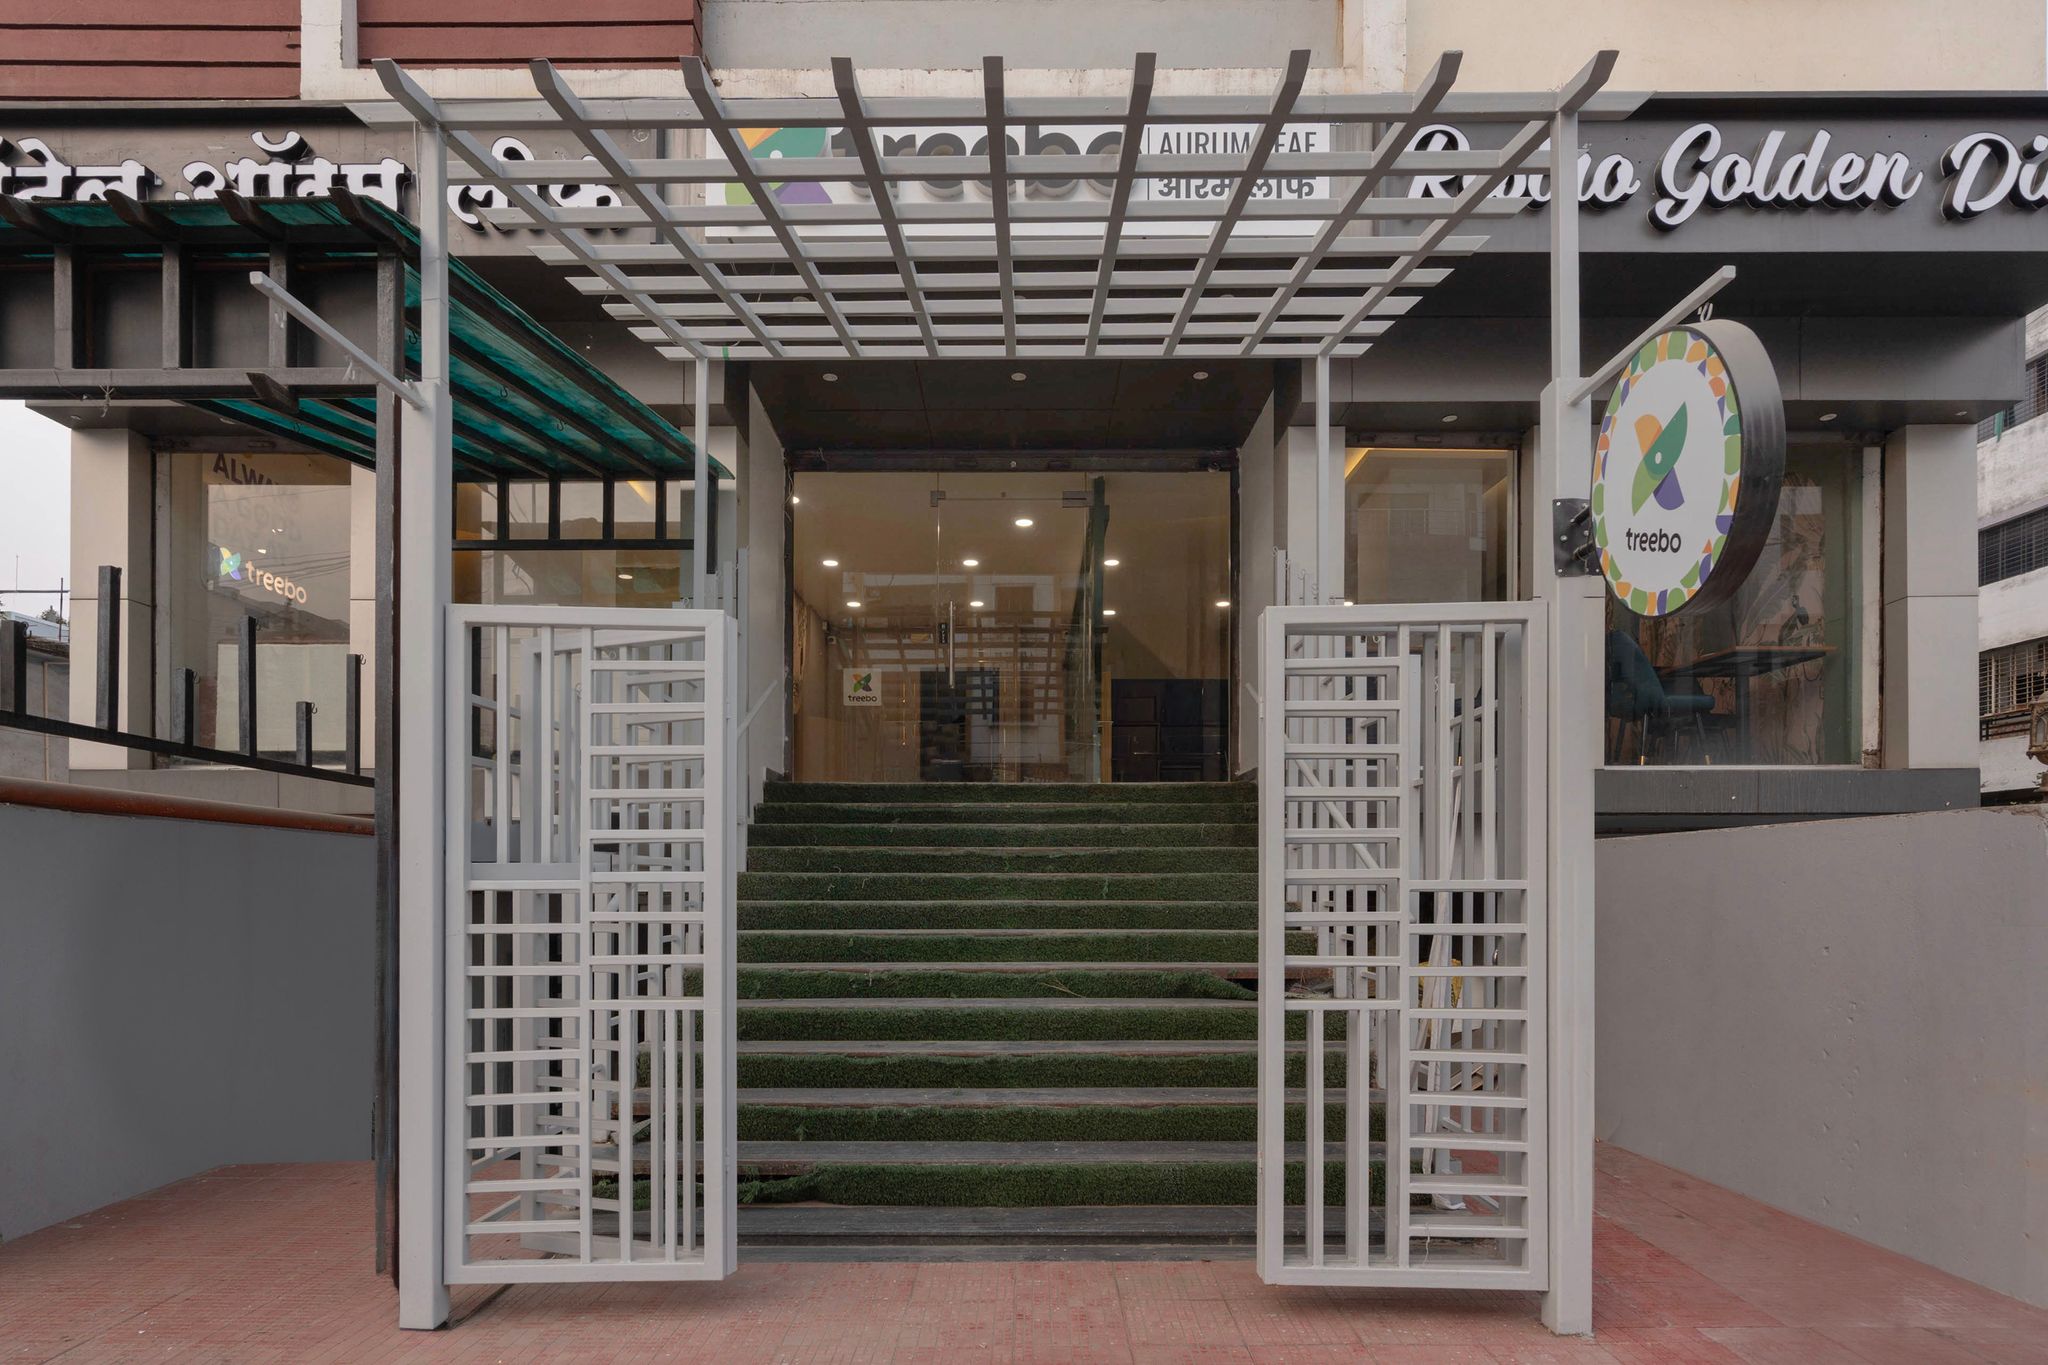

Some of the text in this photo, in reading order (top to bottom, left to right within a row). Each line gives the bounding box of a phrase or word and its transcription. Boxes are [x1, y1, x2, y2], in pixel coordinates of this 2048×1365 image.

[1654, 123, 1924, 226] Golden
[1948, 132, 2048, 213] Di
[1625, 527, 1682, 553] treebo
[245, 560, 307, 604] treebo
[847, 694, 878, 702] treebo
